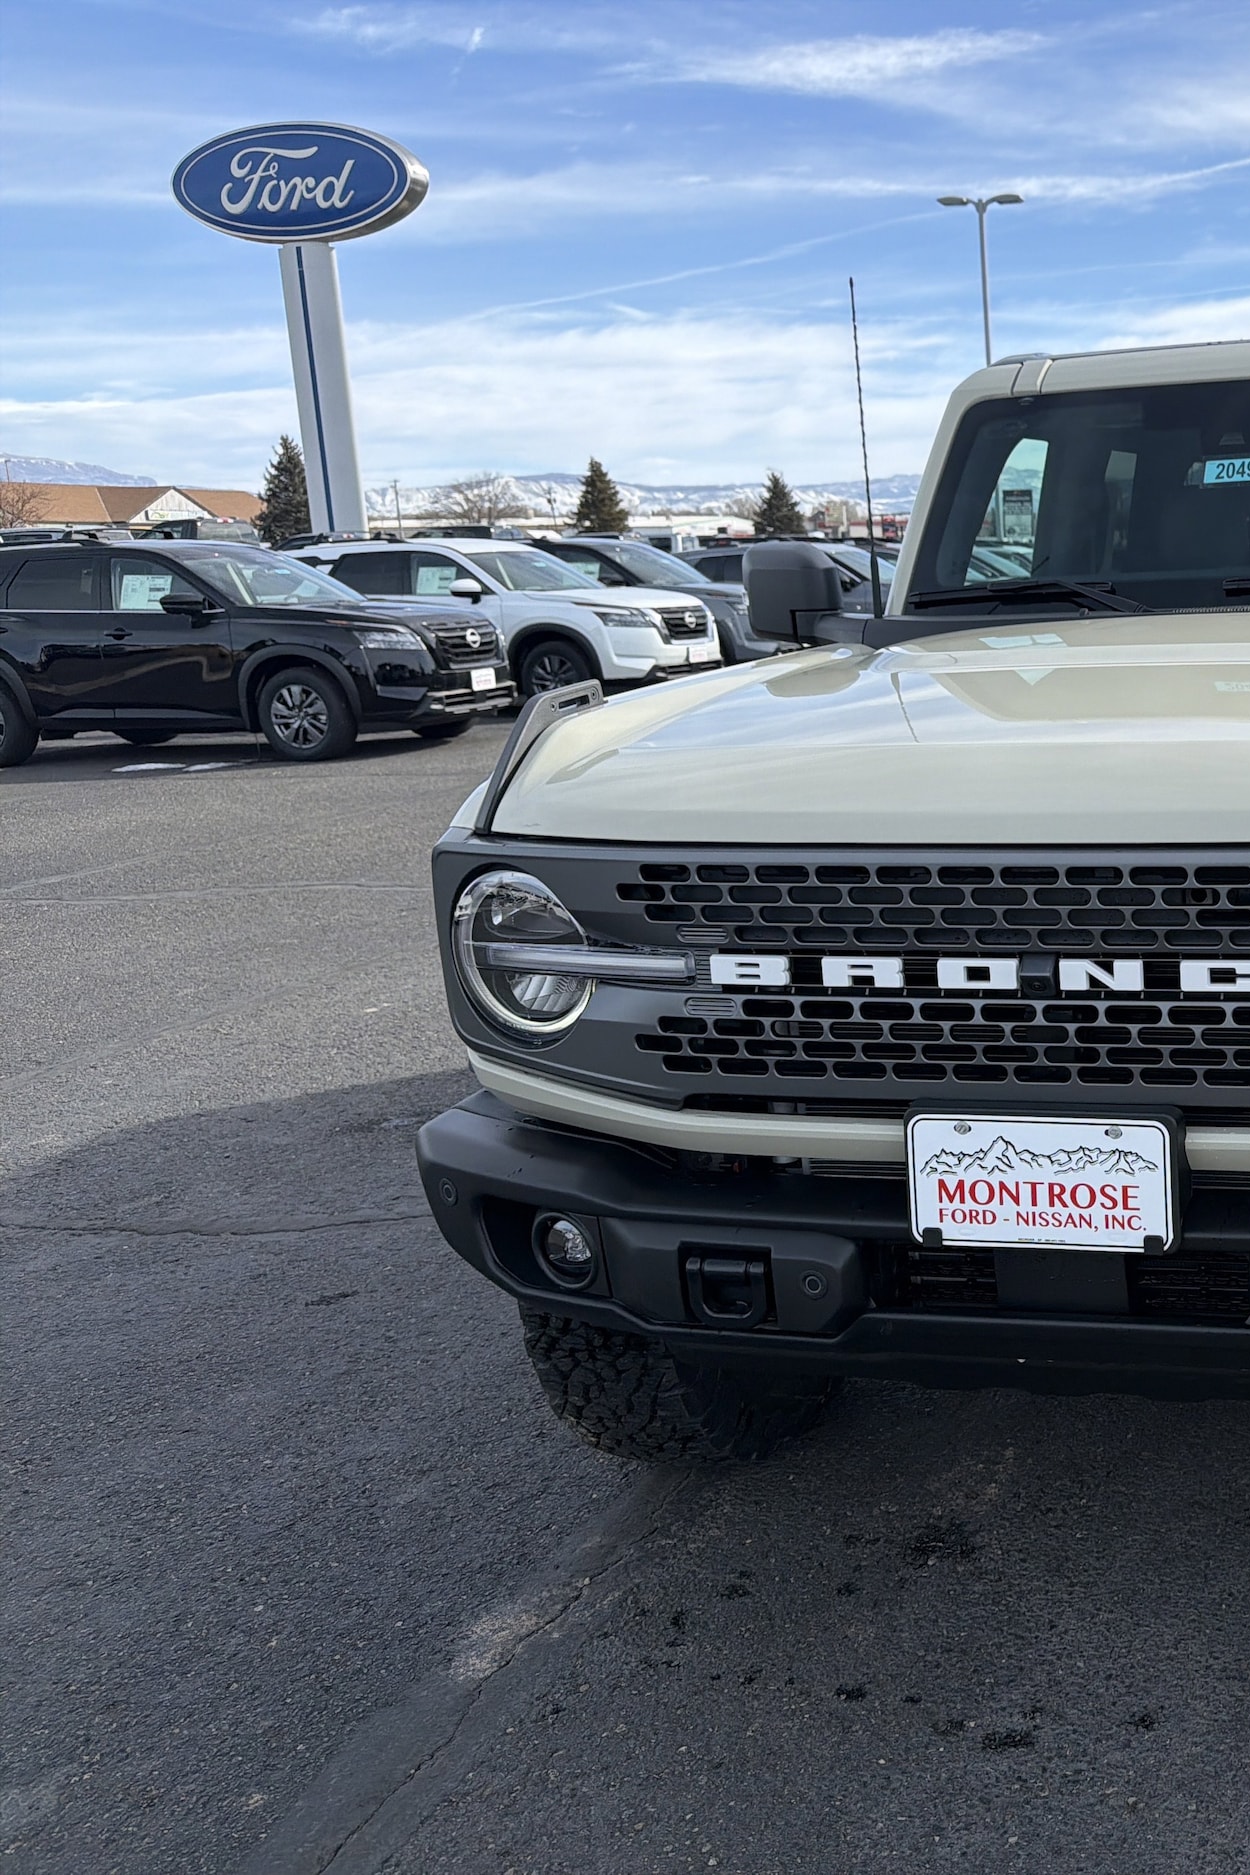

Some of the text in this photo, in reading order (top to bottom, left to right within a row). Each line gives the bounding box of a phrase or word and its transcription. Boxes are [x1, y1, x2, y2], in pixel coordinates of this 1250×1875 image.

[221, 146, 355, 214] Ford
[937, 1178, 1141, 1211] MONTROSE
[938, 1208, 997, 1225] FORD
[1016, 1211, 1098, 1232] NISSAN,
[1104, 1215, 1147, 1231] INC.
